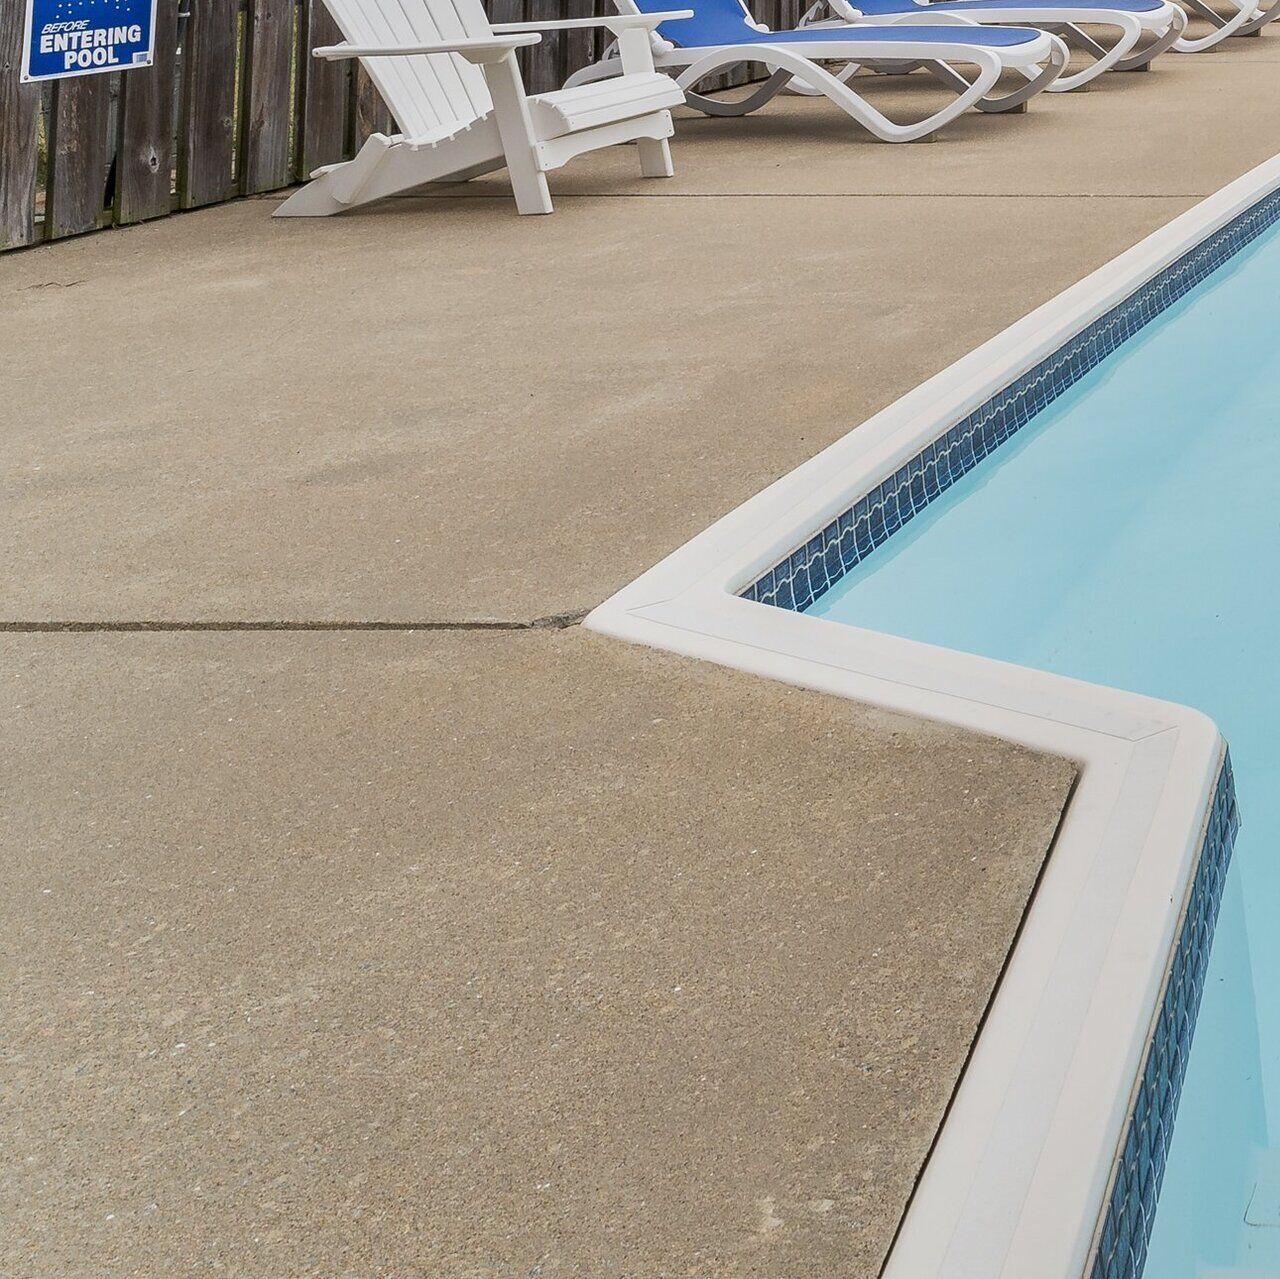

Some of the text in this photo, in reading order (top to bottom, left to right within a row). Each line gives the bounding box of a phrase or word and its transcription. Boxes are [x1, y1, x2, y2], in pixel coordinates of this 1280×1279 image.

[41, 20, 90, 34] BEFORE
[40, 25, 141, 53] ENTERING
[64, 47, 119, 69] POOL
